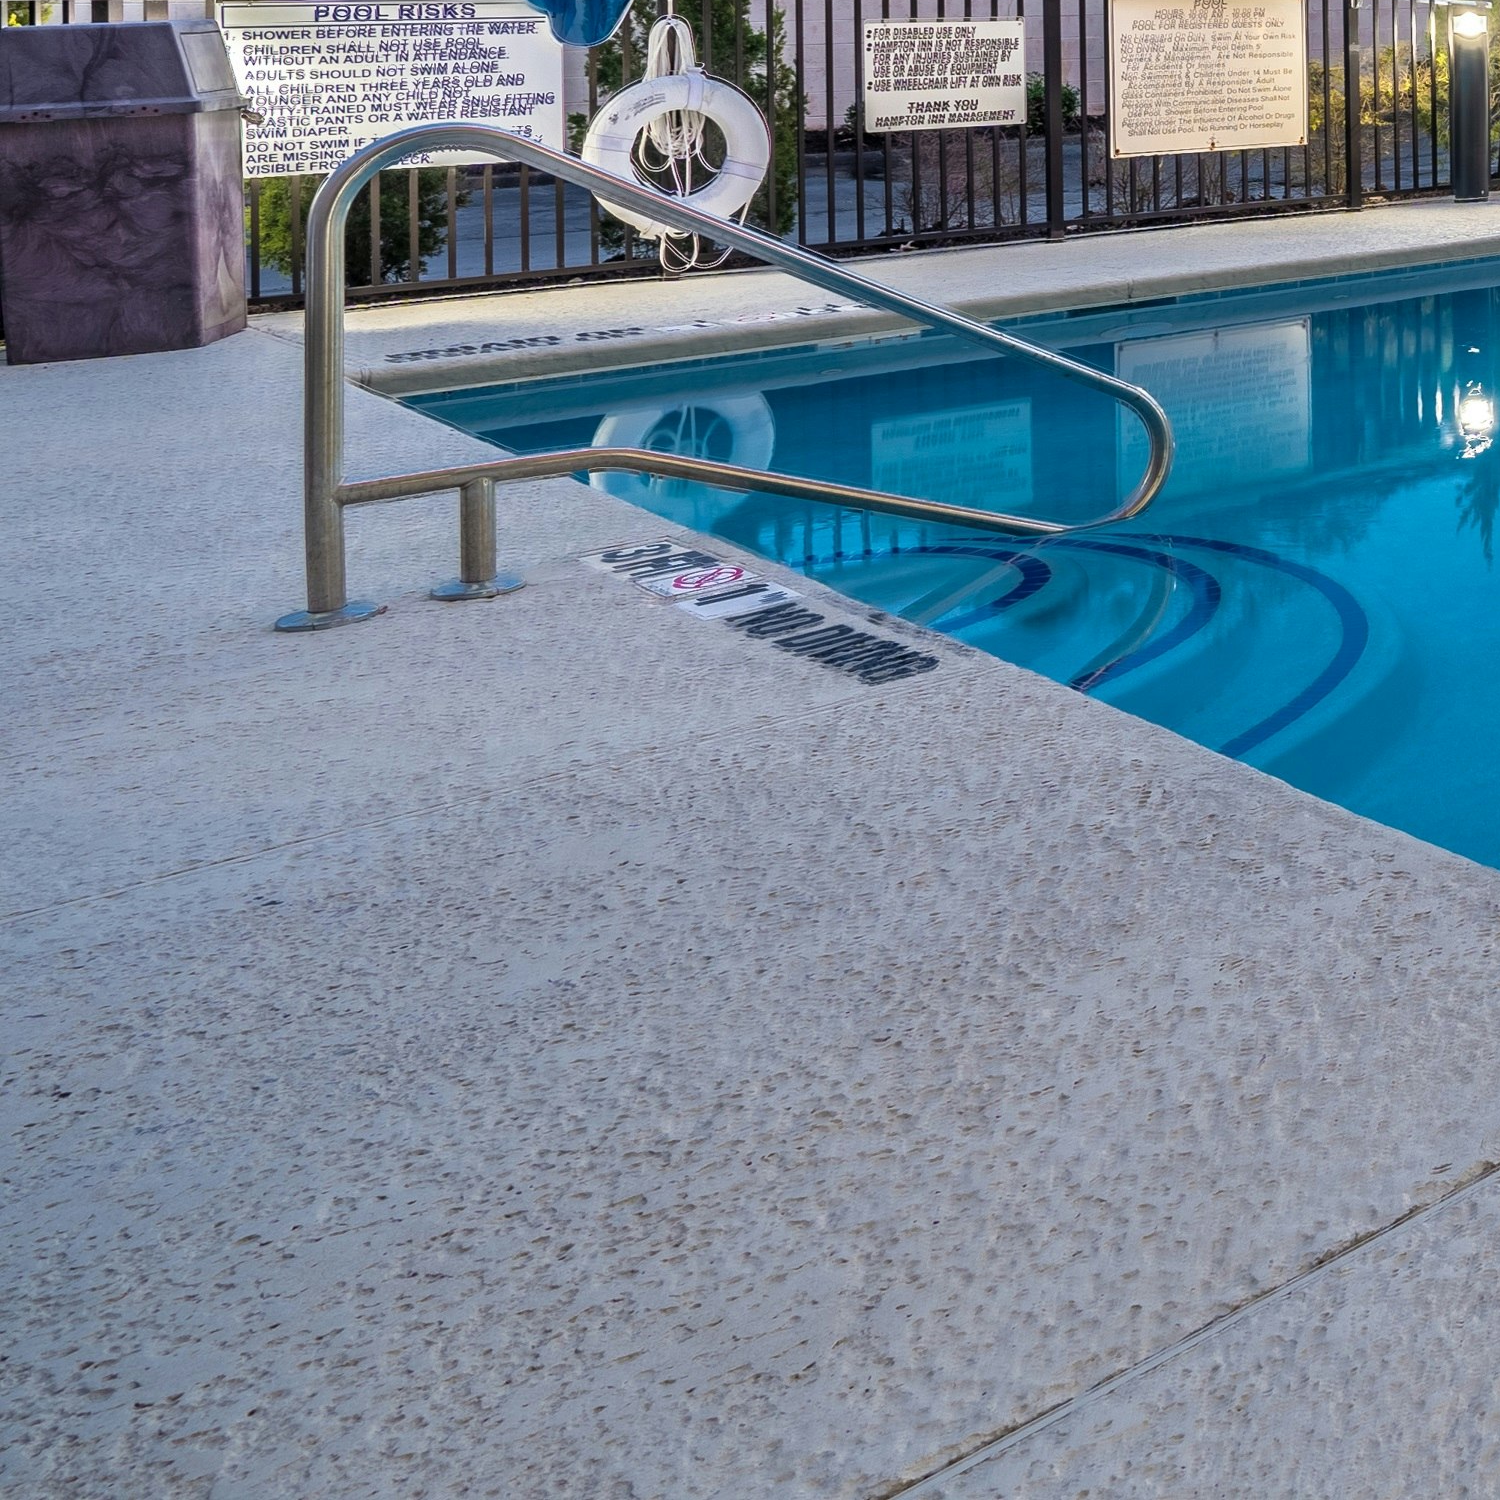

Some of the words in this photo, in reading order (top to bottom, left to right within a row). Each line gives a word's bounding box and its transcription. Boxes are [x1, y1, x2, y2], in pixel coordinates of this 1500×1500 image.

[315, 4, 389, 22] POOL
[399, 3, 476, 20] RISKS
[242, 29, 311, 40] SHOWER
[315, 26, 377, 39] BEFORE
[381, 23, 454, 37] ENTERING
[460, 22, 485, 35] THE
[488, 21, 538, 34] WATER.
[873, 28, 891, 40] FOR
[893, 27, 934, 40] DISABLED
[936, 26, 953, 39] USE
[954, 26, 977, 38] ONLY
[1179, 20, 1229, 30] REGISTERED
[1231, 20, 1262, 29] GUESTS
[1265, 19, 1285, 28] ONLY
[243, 44, 322, 56] CHILDREN
[326, 41, 376, 55] SHALL
[379, 40, 409, 53] NOT
[413, 39, 442, 52] USE
[445, 37, 485, 51] POOL
[873, 41, 916, 54] HAMPTON
[917, 40, 933, 53] INN
[935, 40, 944, 52] IS
[945, 39, 963, 52] NOT
[964, 37, 1020, 51] RESPONSIBLE
[244, 55, 315, 66] WITHOUT
[319, 54, 340, 65] AN
[343, 52, 391, 64] ADULT
[395, 50, 410, 62] IN
[412, 46, 510, 62] ATTENDANCE.
[873, 53, 891, 66] FOR
[892, 53, 911, 65] ANY
[912, 51, 952, 64] INJURIES
[952, 51, 999, 63] SUSTAINED
[1000, 50, 1012, 62] BY
[245, 69, 306, 81] ADULTS
[310, 68, 372, 80] SHOULD
[376, 64, 406, 78] NOT
[410, 63, 448, 77] SWIM
[873, 66, 892, 79] USE
[892, 65, 906, 78] OR
[907, 64, 936, 77] ABUSE
[936, 63, 949, 76] OF
[950, 62, 998, 76] EQUIPMENT
[245, 84, 275, 96] ALL
[278, 82, 356, 95] CHILDREN
[360, 80, 409, 92] THREE
[412, 76, 461, 90] YEARS
[464, 75, 493, 88] OLD
[496, 72, 526, 87] AND
[873, 79, 892, 92] USE
[892, 77, 949, 91] WHEELCHAIR
[950, 76, 968, 89] LIFT
[969, 75, 981, 88] AT
[981, 75, 1001, 88] OWN
[1002, 73, 1022, 87] RISK
[250, 93, 323, 107] OUNGER
[326, 92, 358, 105] AND
[361, 91, 392, 104] ANY
[395, 88, 439, 102] CHILD
[442, 85, 472, 100] NOT
[371, 100, 409, 113] MUST
[413, 97, 458, 112] WEAR
[461, 93, 501, 109] SNUG
[504, 91, 556, 107] FITTING
[315, 113, 365, 126] PANTS
[367, 112, 391, 124] OR
[392, 111, 404, 123] A
[406, 107, 457, 122] WATER
[460, 102, 534, 119] RESISTANT
[907, 101, 950, 114] THANK
[953, 99, 979, 112] YOU
[875, 114, 925, 128] HAMPTON
[927, 112, 946, 126] INN
[948, 109, 1016, 124] MANAGEMENT
[246, 127, 289, 140] SWIM
[291, 125, 353, 138] DIAPER.
[246, 141, 269, 154] DO
[273, 140, 305, 152] NOT
[310, 138, 350, 151] SWIM
[354, 137, 367, 148] IF
[245, 160, 305, 175] VISIBLE
[309, 159, 343, 173] FRO
[246, 152, 279, 164] ARE
[601, 543, 672, 563] 3
[612, 550, 721, 578] FT
[723, 601, 826, 639] NO
[770, 623, 941, 686] DIVING
